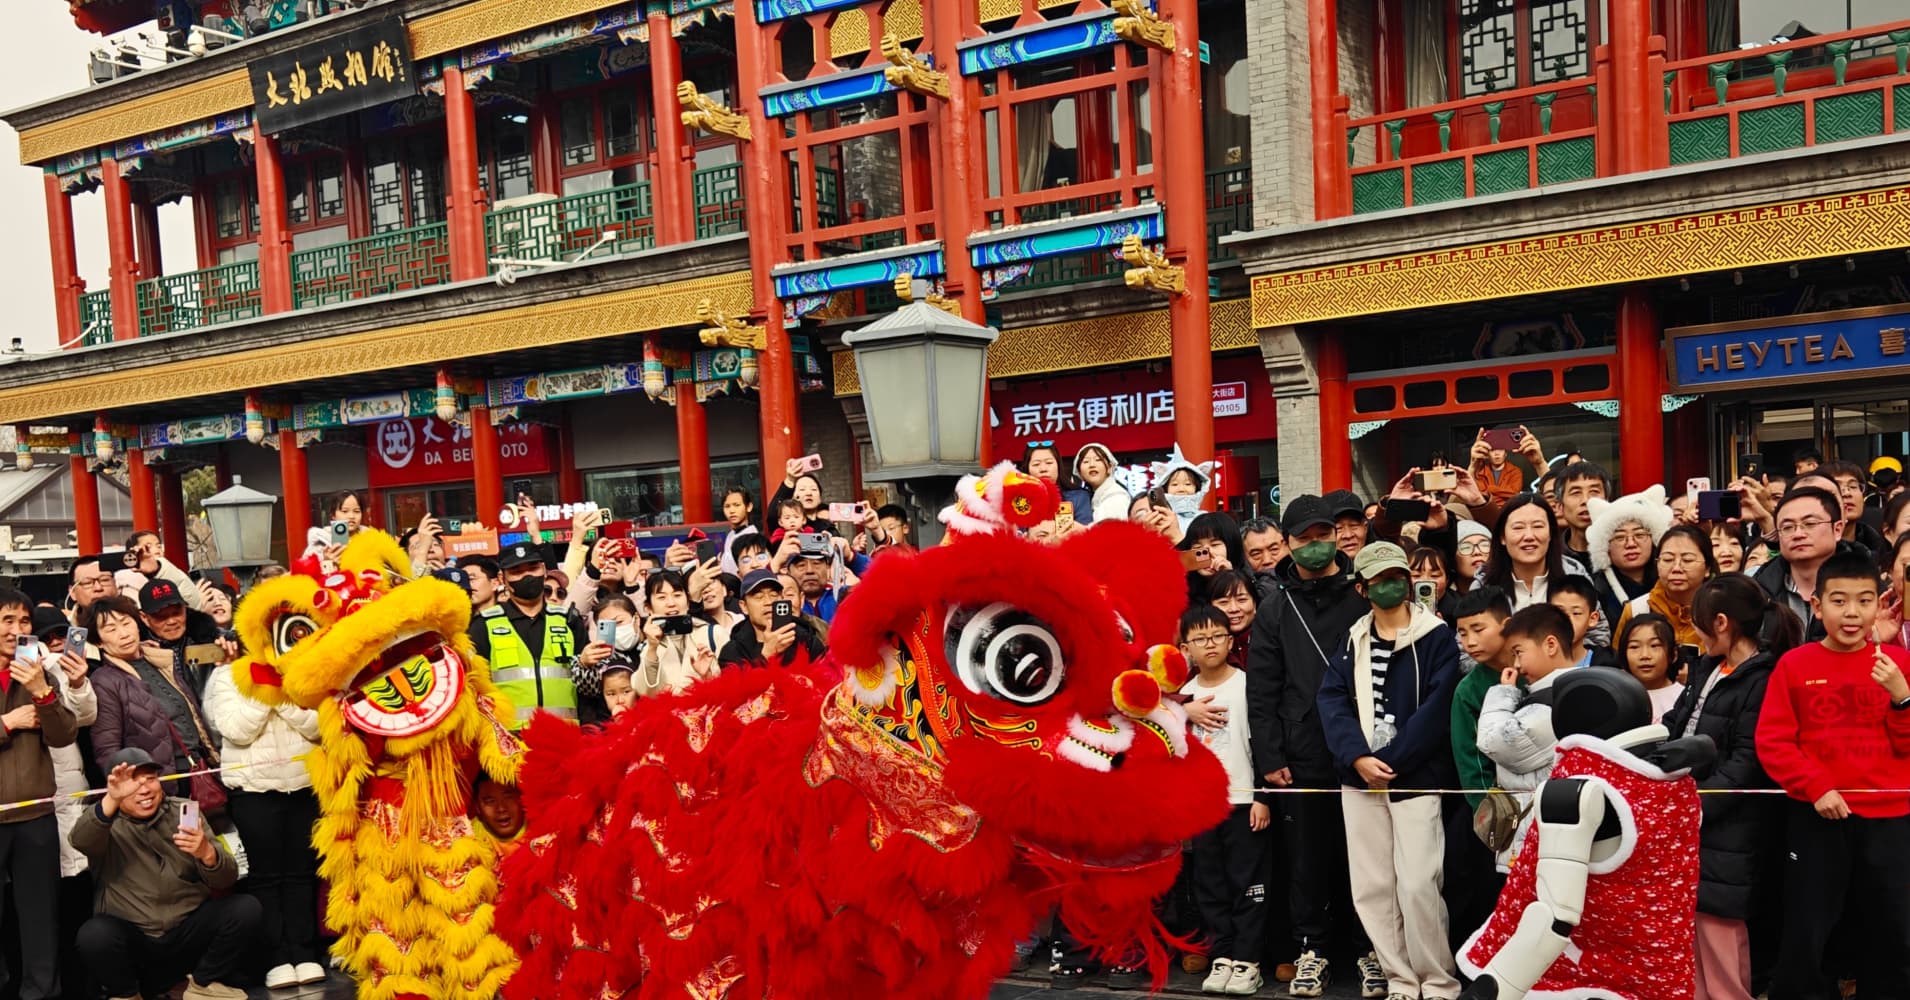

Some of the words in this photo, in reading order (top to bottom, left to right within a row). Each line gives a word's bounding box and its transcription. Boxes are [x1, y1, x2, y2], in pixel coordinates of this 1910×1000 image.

[1696, 333, 1855, 373] HEYTEA
[1879, 327, 1910, 355] 喜
[1011, 390, 1175, 437] 京东便利店
[1214, 403, 1241, 413] 60105
[424, 451, 443, 465] DA
[501, 442, 528, 458] OTO
